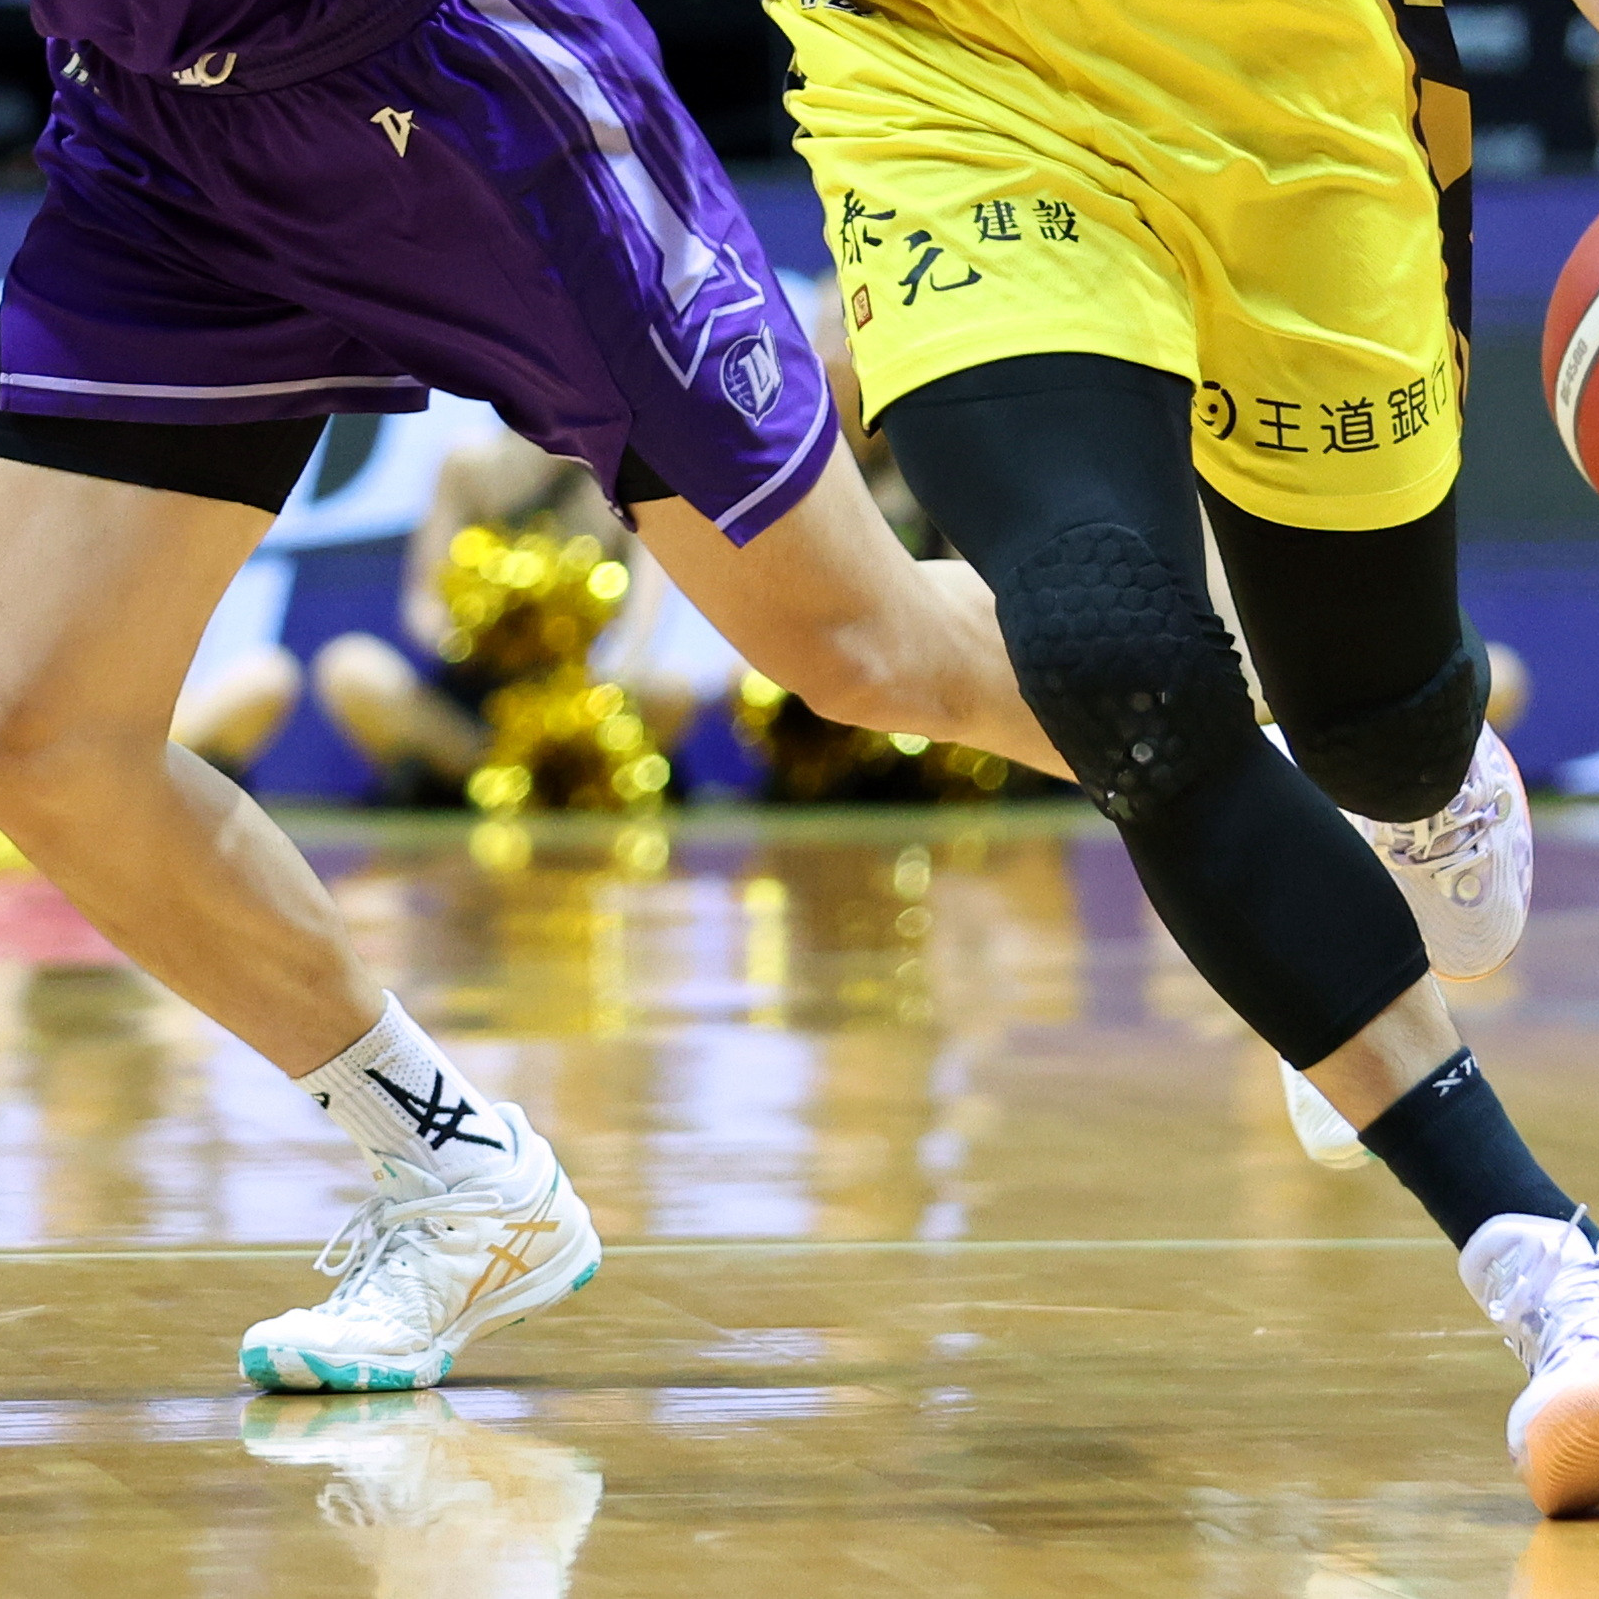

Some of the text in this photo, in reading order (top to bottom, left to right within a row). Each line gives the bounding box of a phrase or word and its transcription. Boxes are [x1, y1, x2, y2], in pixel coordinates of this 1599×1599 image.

[970, 198, 1080, 244] 建設
[1254, 347, 1448, 455] 王道銀行
